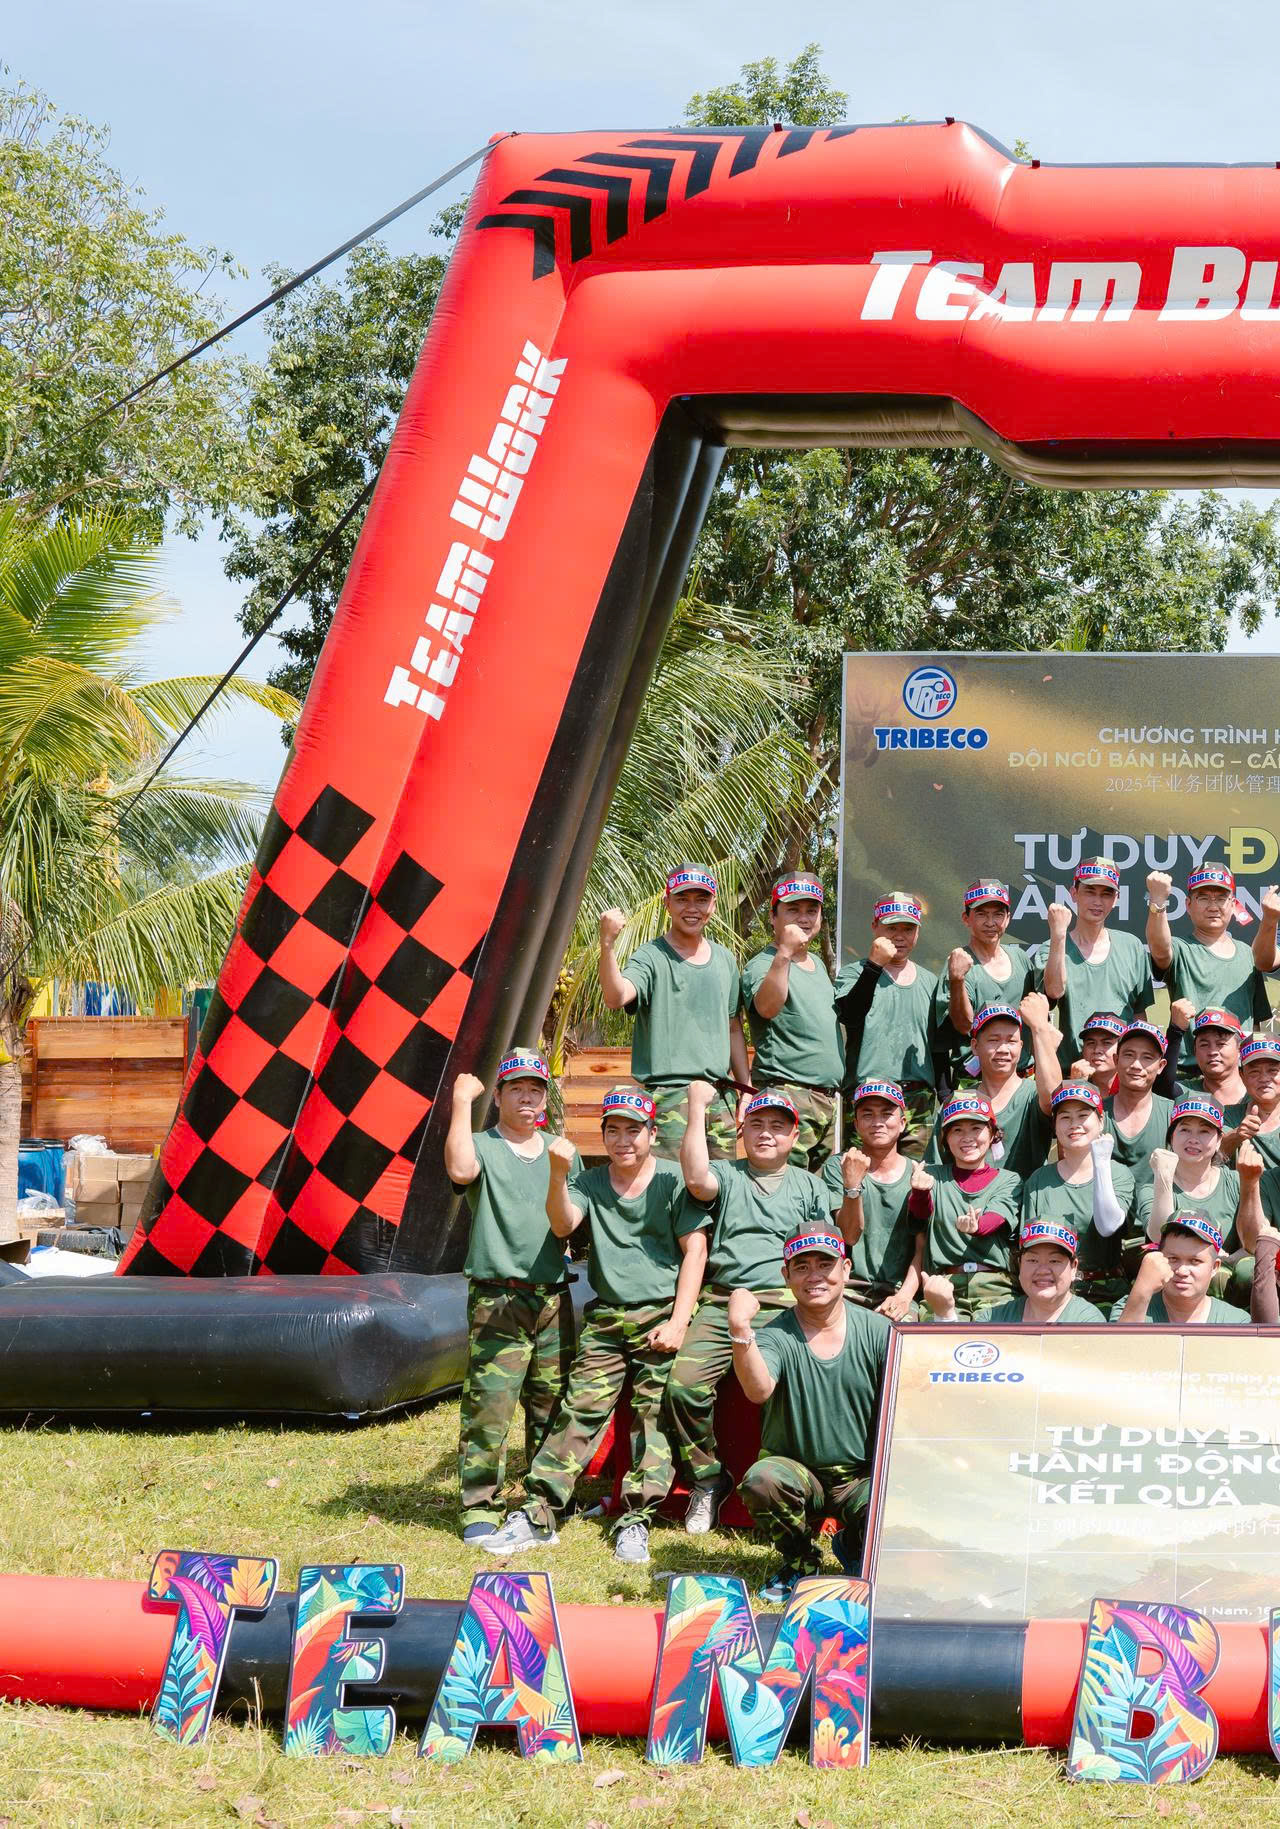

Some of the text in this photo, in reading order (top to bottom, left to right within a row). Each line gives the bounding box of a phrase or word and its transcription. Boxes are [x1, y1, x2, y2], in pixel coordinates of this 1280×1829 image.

[875, 727, 989, 750] TRIBECO
[1098, 724, 1195, 745] CHƯƠNG
[1200, 724, 1267, 745] TRÌNH
[1008, 745, 1048, 772] ĐỘI
[1055, 747, 1101, 769] NGŨ
[1109, 749, 1155, 769] BÁN
[1162, 749, 1225, 769] HÀNG
[1014, 826, 1088, 871] TƯ
[1103, 835, 1216, 871] DUY
[676, 873, 716, 889] TRIBECO
[1082, 866, 1117, 880] TRIBECO
[1188, 872, 1224, 884] TRIBECO
[881, 904, 919, 915] TRIBECO
[979, 1007, 1017, 1020] TRIBECO
[1243, 1041, 1280, 1054] TRIBECO
[500, 1058, 541, 1072] TRIBECO
[862, 1085, 902, 1099] TRIBECO
[1179, 1103, 1220, 1119] TRIBECO
[1030, 1226, 1075, 1245] TRIBECO
[790, 1236, 839, 1252] TRIBECO
[929, 1372, 1025, 1383] TRIBECO
[1046, 1423, 1109, 1447] TƯ
[1120, 1426, 1216, 1449] DUY
[1009, 1448, 1142, 1473] HÀNH
[1037, 1477, 1125, 1504] KẾT
[1138, 1478, 1243, 1509] QUẢ
